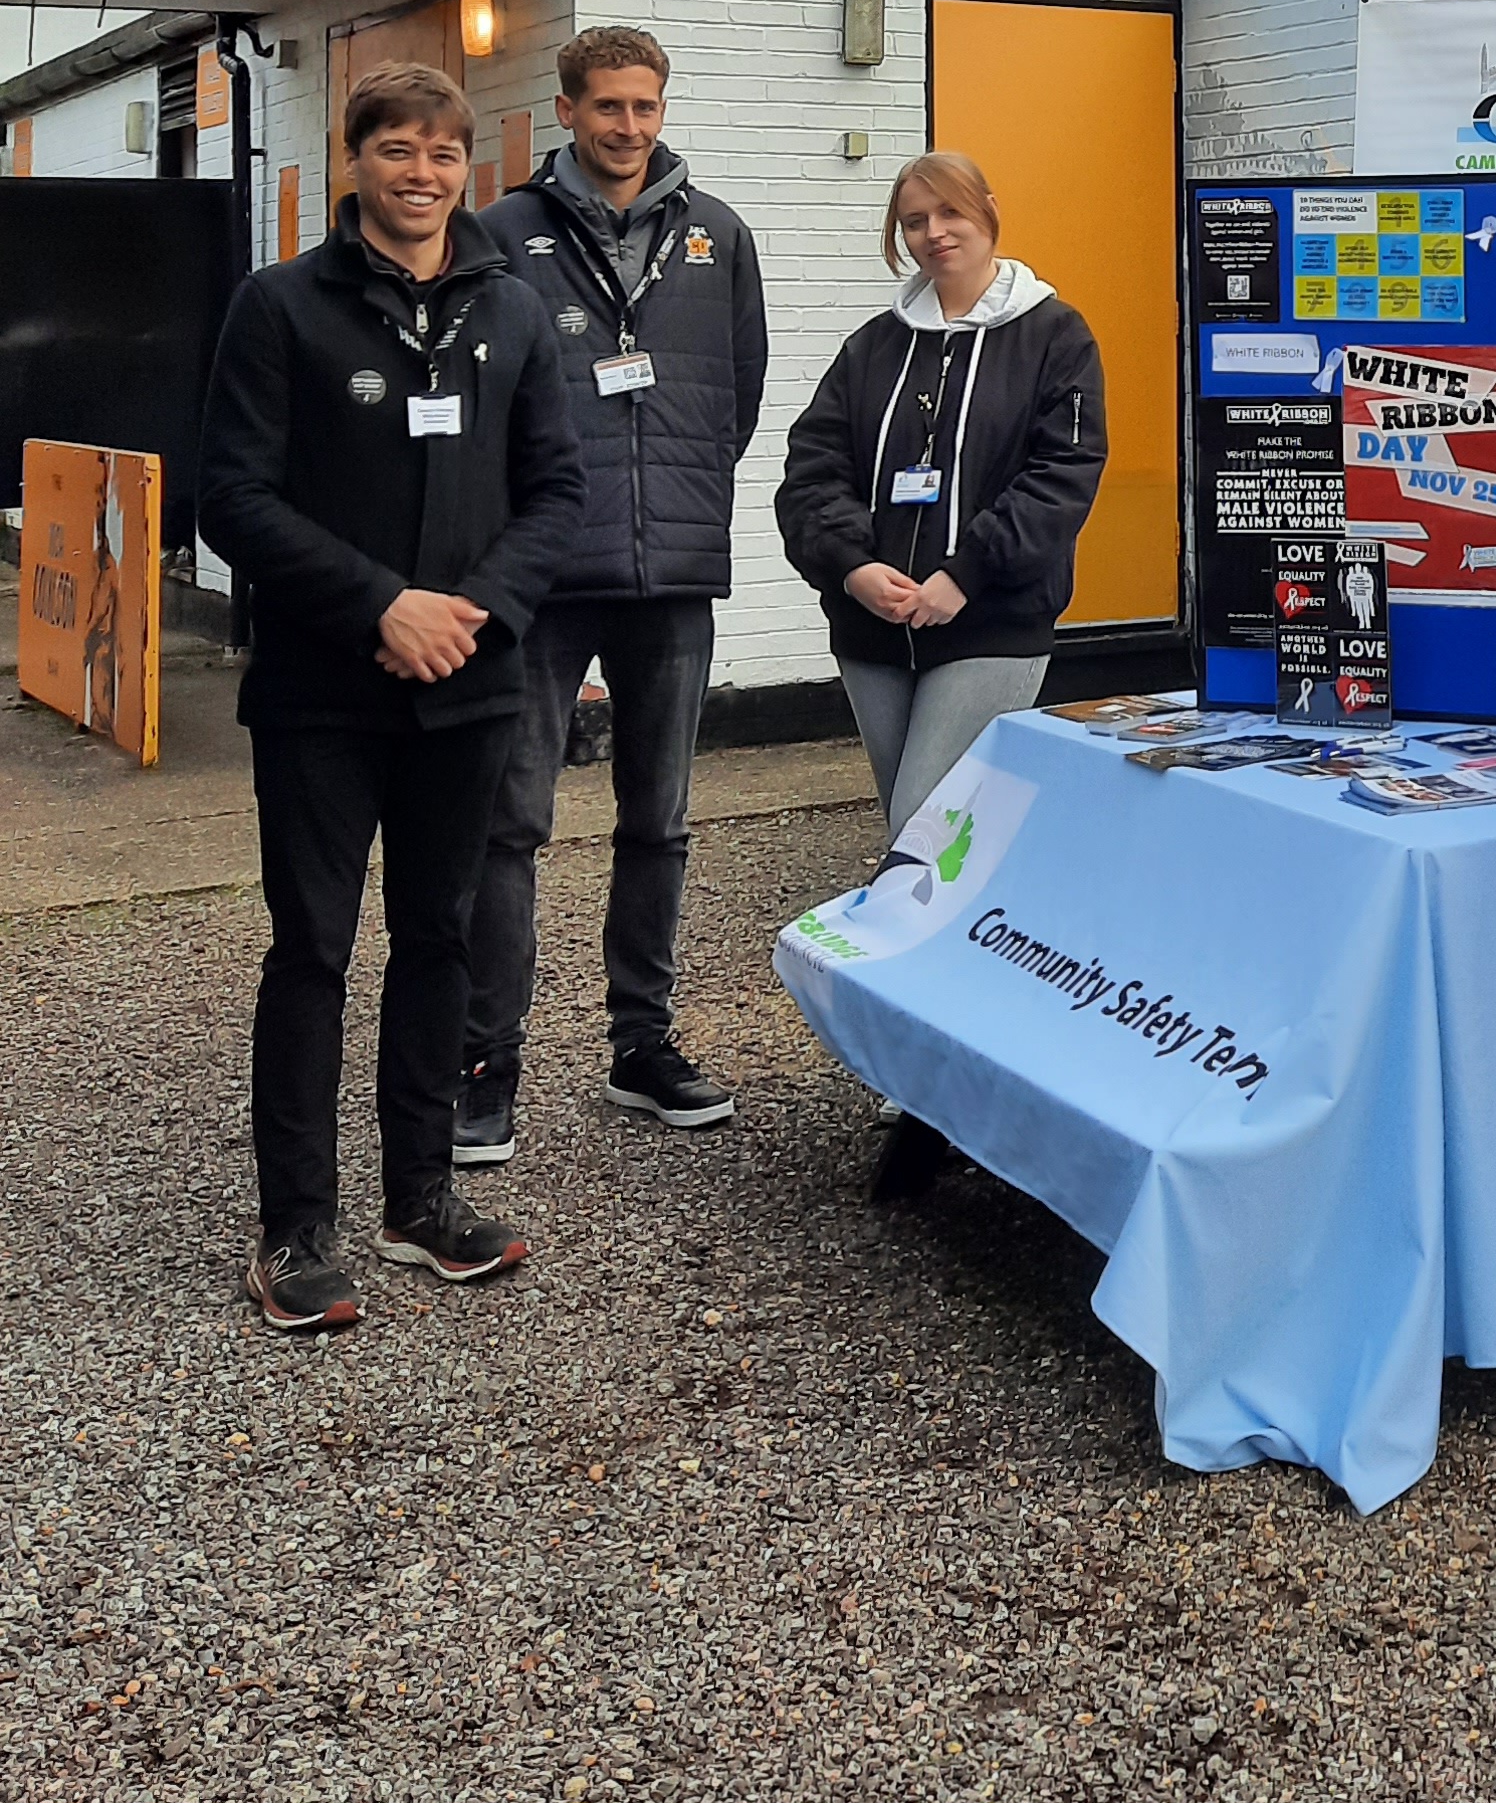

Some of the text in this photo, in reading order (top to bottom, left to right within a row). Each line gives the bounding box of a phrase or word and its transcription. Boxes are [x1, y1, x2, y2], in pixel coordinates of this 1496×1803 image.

[1226, 348, 1304, 359] WHITE RIBBON
[1347, 352, 1469, 400] WHITE
[1230, 409, 1329, 420] WHITE RIBBON
[1257, 437, 1302, 446] MAKE THE
[1357, 431, 1428, 462] DAY
[1226, 450, 1334, 460] WHITE RIBBON PROMISE
[1261, 468, 1297, 478] NEVER
[1216, 479, 1344, 491] COMMIT, EXCUSE OR
[1408, 469, 1466, 496] NOV
[1216, 491, 1345, 501] REMAIN SILENT ABOUT
[1217, 502, 1345, 515] MALE VIOLENCE
[1217, 516, 1282, 529] AGAINST
[1287, 516, 1346, 529] WOMEN
[1277, 544, 1325, 563] LOVE
[1278, 571, 1326, 583] EQUALITY
[1280, 635, 1325, 644] ANOTHER
[1281, 643, 1327, 655] WORLD
[1339, 639, 1387, 659] LOVE
[1339, 666, 1388, 678] EQUALITY
[967, 907, 1116, 1012] Community
[1101, 980, 1204, 1058] Safety
